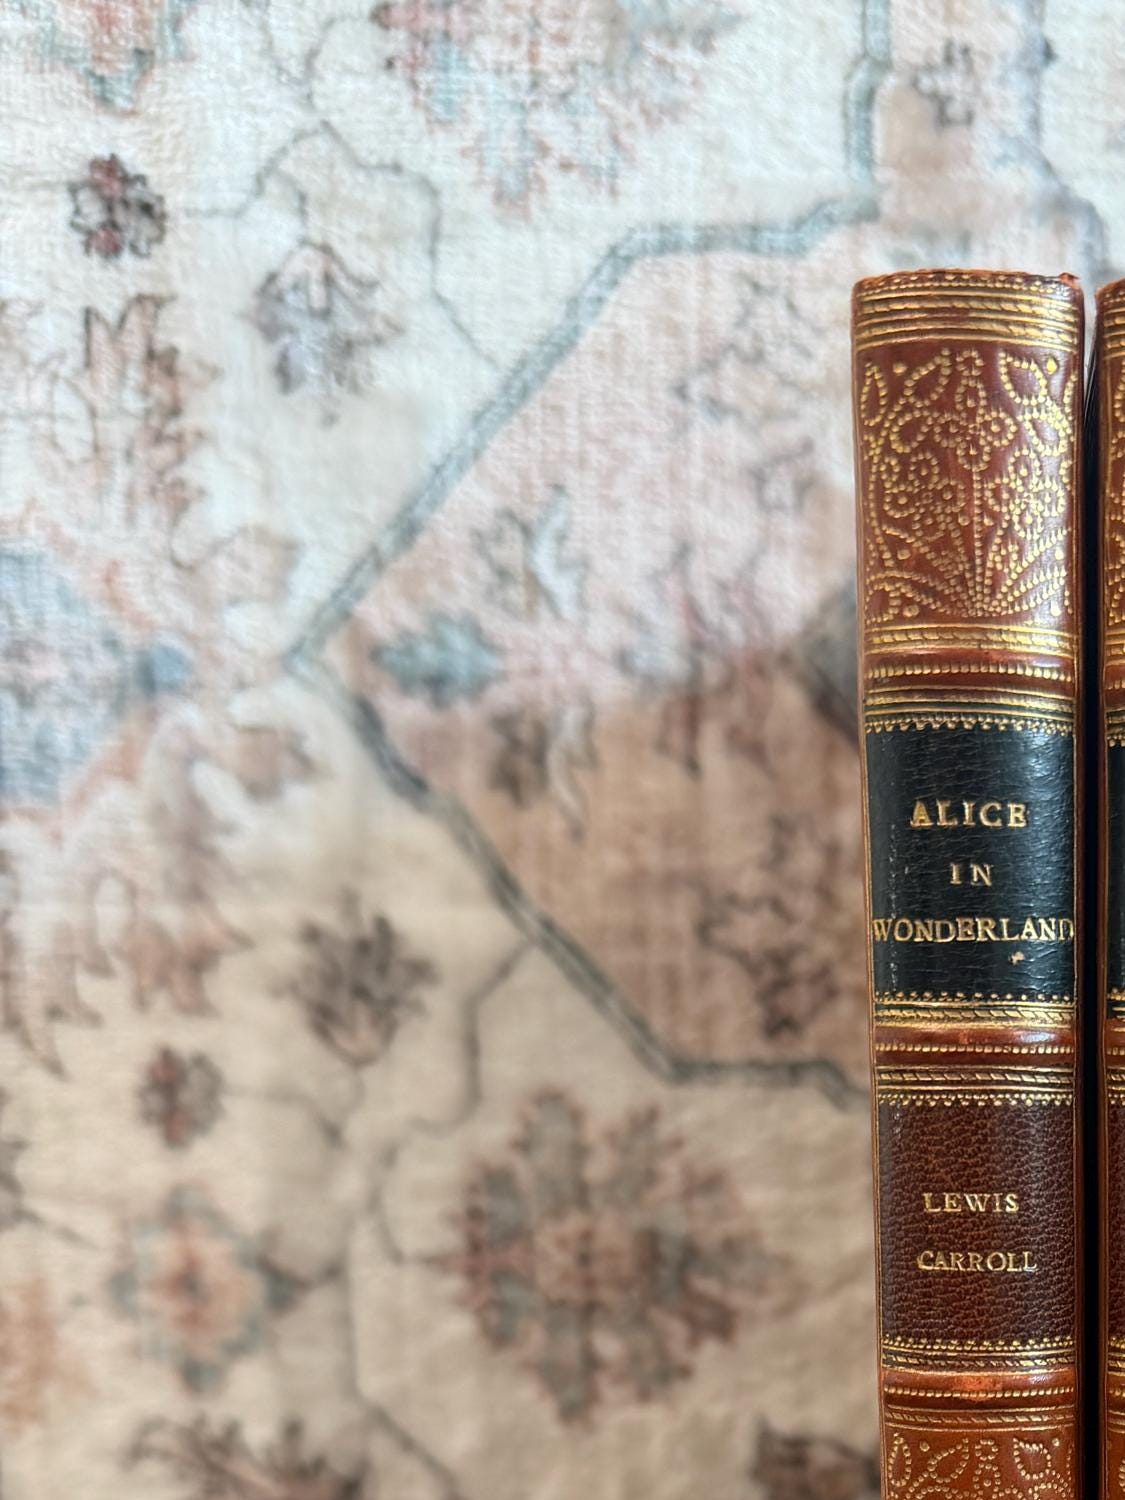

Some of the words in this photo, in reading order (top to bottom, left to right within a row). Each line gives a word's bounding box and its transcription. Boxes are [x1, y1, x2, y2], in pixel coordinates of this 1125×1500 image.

[910, 800, 1030, 828] ALICE
[949, 862, 993, 886] IN
[872, 917, 1074, 943] WONDERLAND
[922, 1191, 1019, 1213] LEWIS
[916, 1250, 1038, 1272] CARROLL
